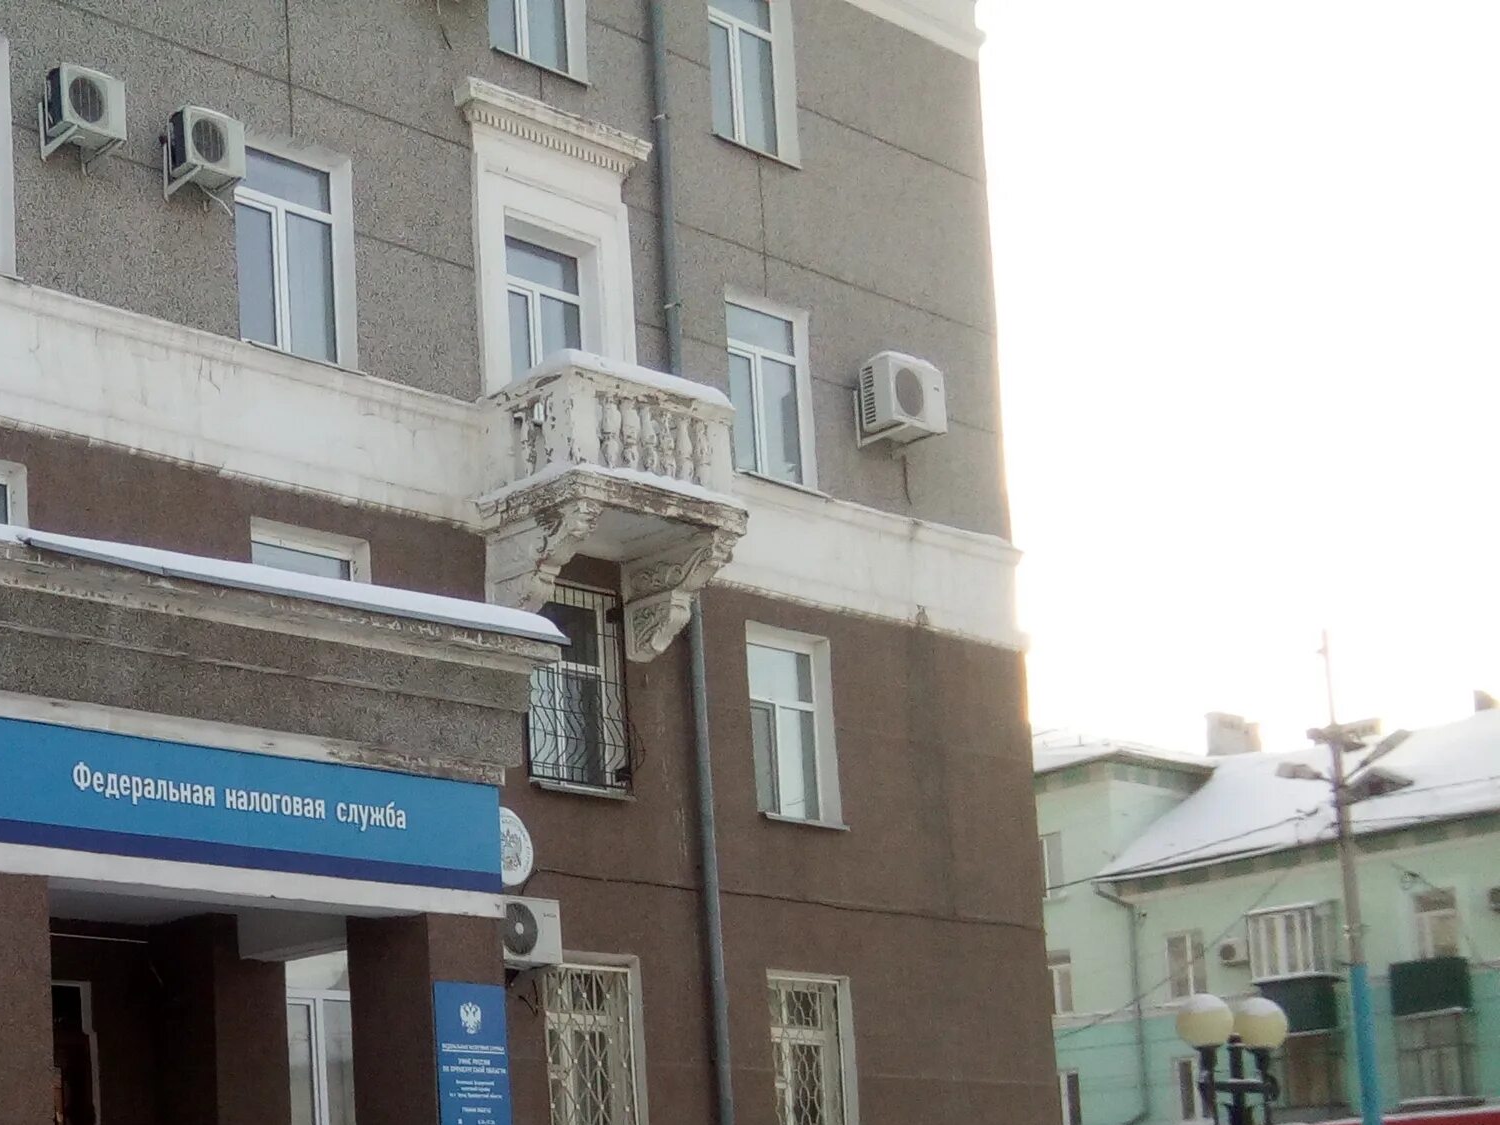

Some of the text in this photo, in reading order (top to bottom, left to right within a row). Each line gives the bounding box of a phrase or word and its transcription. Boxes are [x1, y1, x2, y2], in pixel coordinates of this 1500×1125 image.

[72, 761, 407, 831] Федеральная налоговая служба
